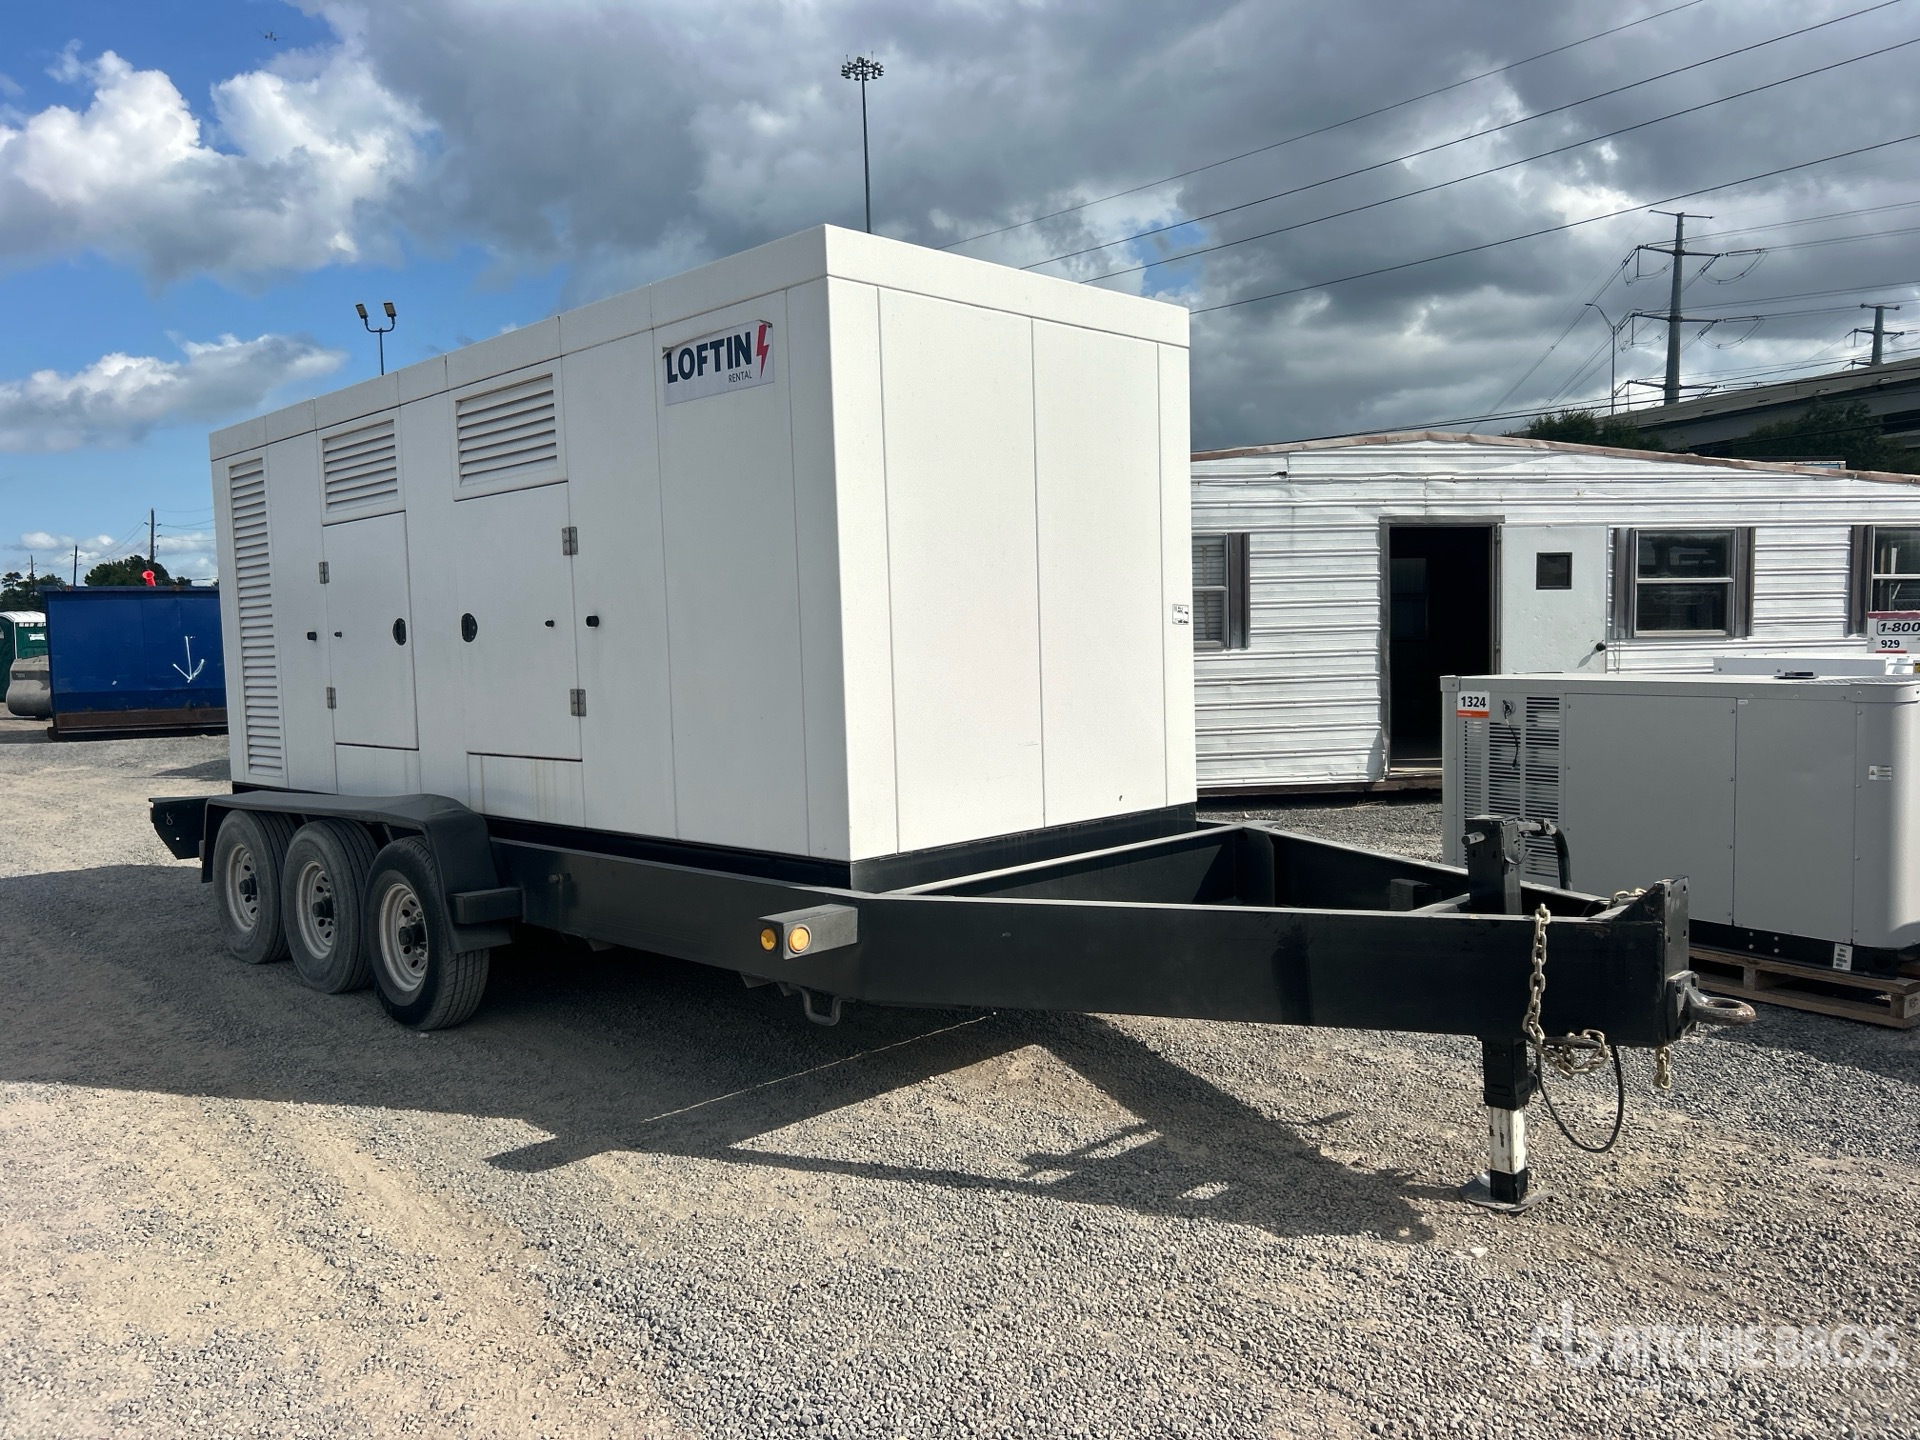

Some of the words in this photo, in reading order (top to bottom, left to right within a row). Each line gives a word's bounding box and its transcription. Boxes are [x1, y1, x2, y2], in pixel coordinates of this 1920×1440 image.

[666, 331, 752, 384] LOFTIN
[728, 370, 752, 383] RENTAL
[1880, 639, 1900, 648] 929
[1461, 695, 1486, 708] 1324
